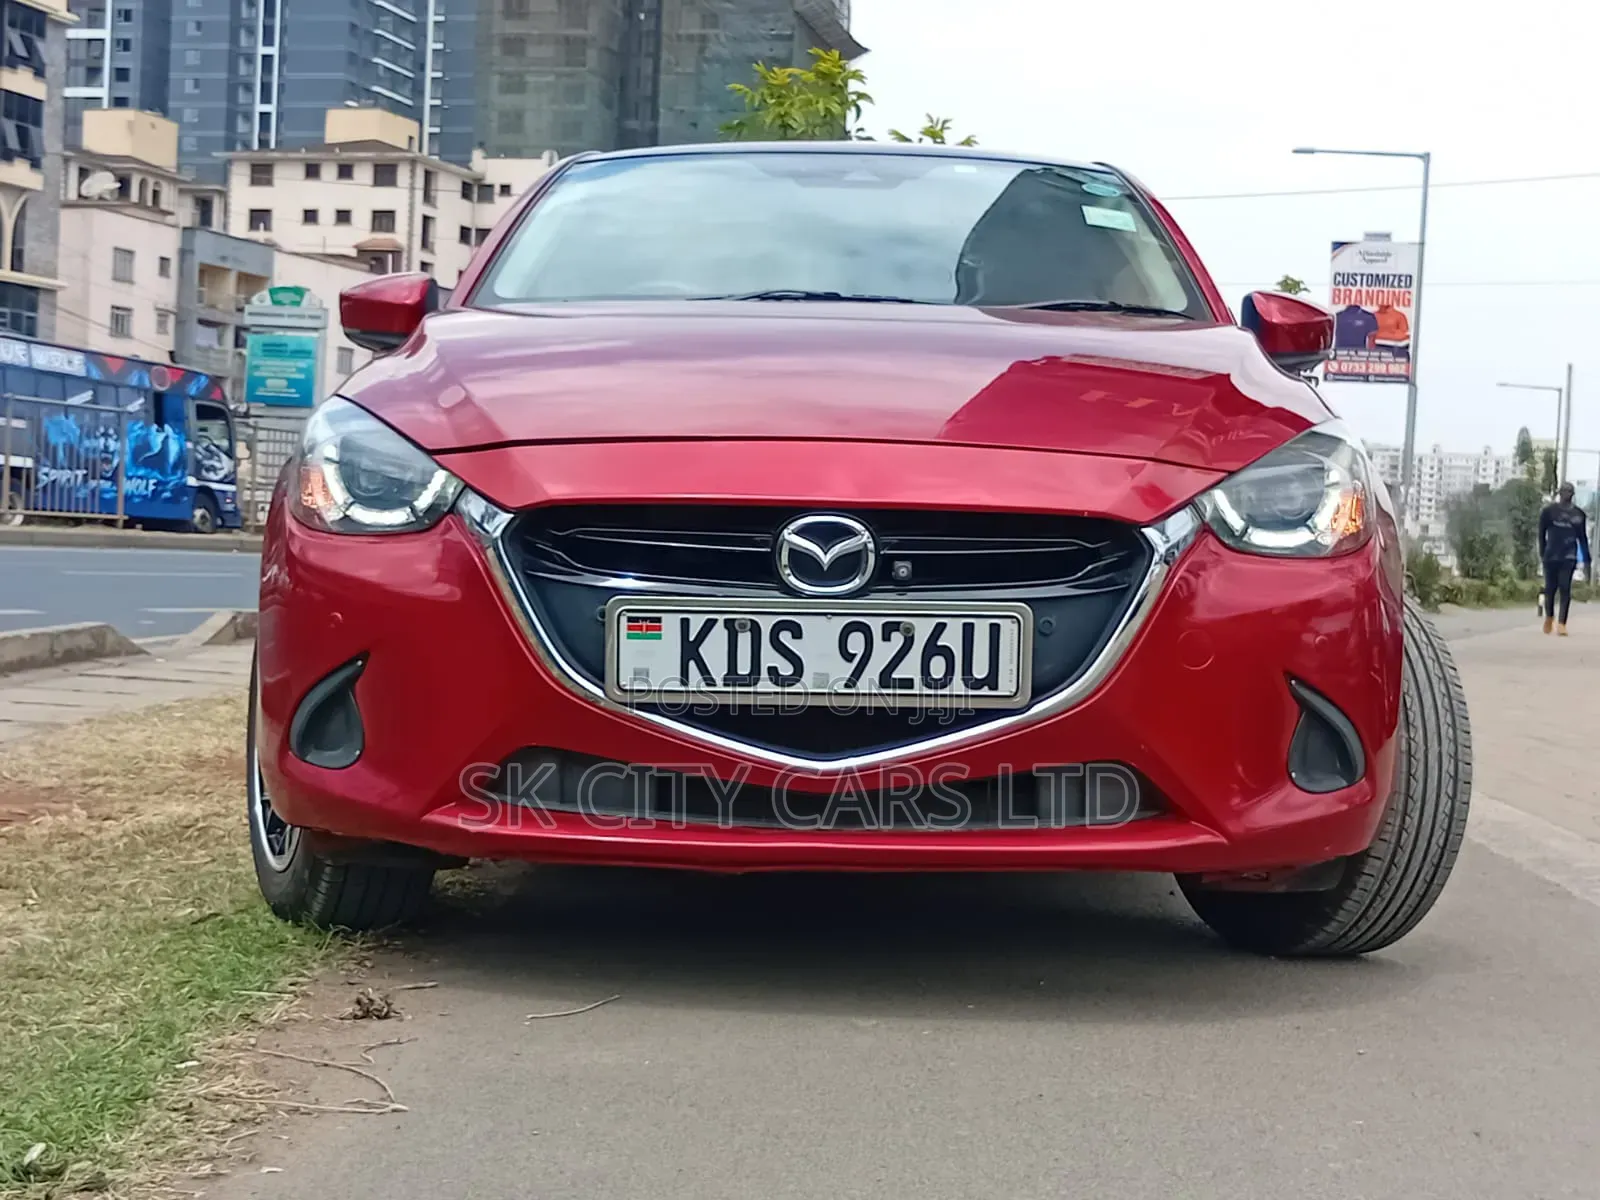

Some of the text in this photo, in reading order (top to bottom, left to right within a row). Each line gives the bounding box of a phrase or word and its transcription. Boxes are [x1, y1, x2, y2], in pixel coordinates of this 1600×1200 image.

[1333, 272, 1412, 288] CUSTOMIZED
[1332, 289, 1411, 307] BRANDING
[37, 467, 88, 488] SPIRIT
[122, 477, 157, 497] WOLF
[680, 617, 804, 688] KDS
[838, 621, 1000, 691] 926U
